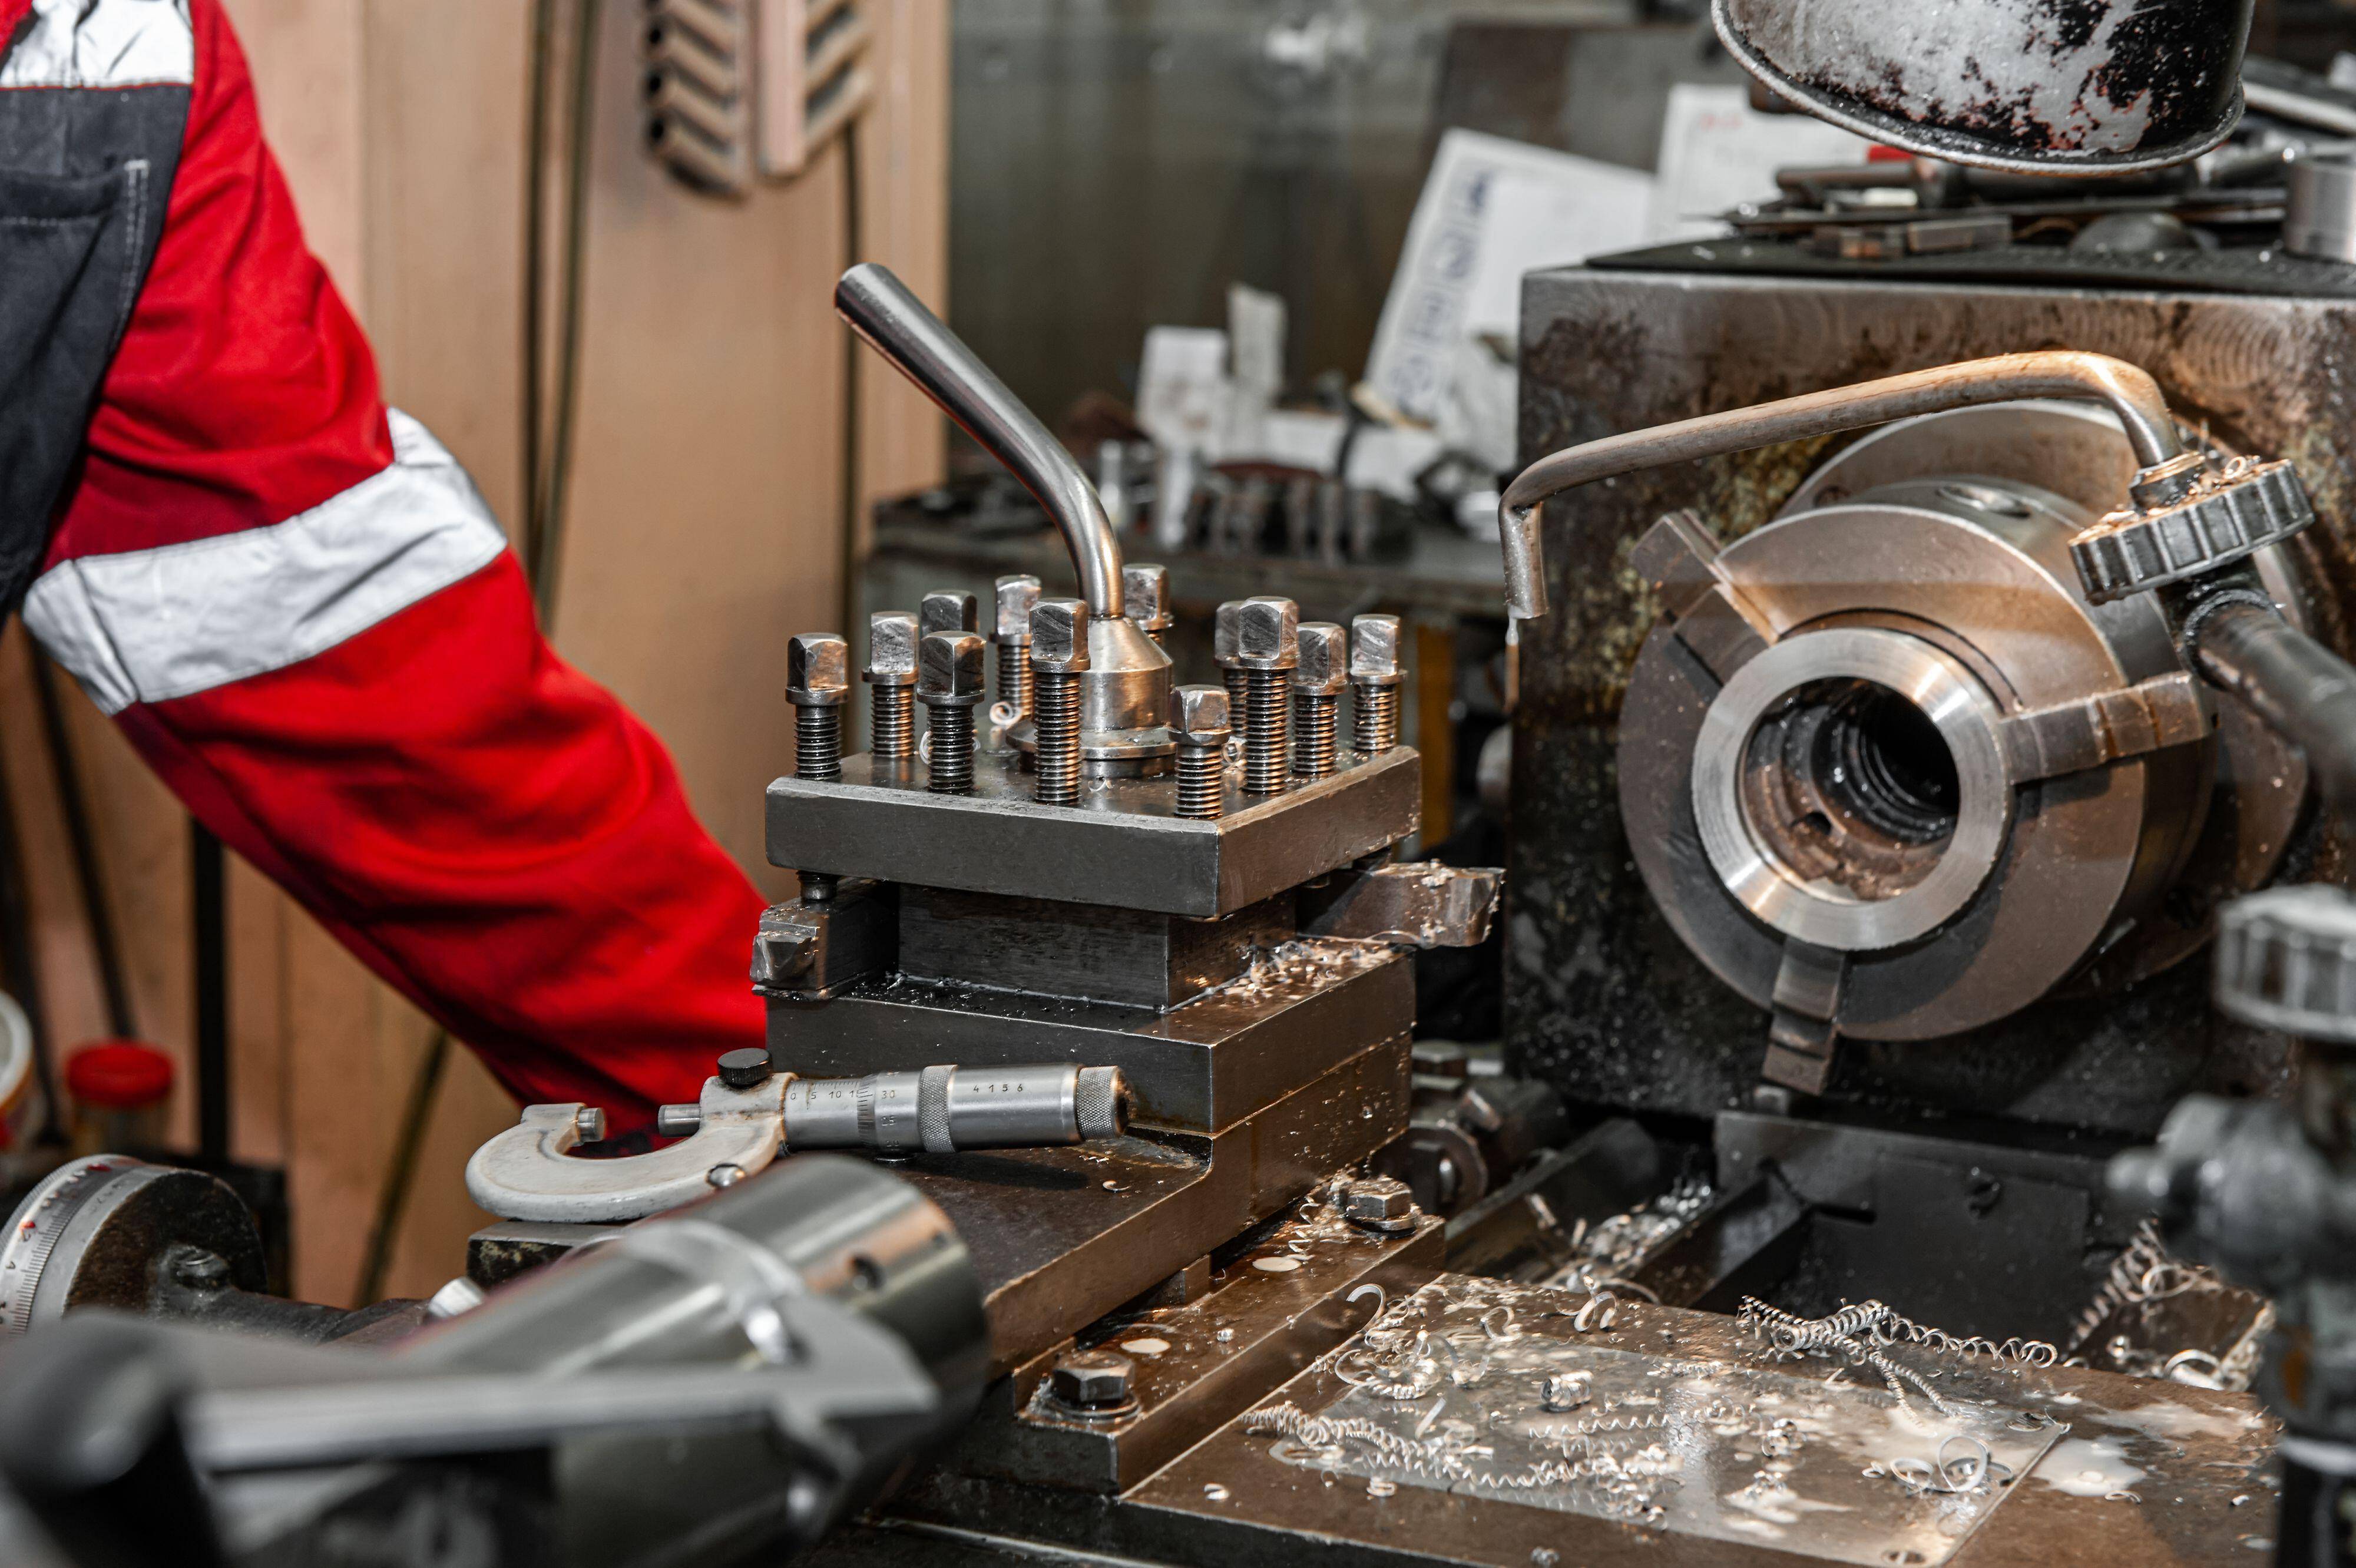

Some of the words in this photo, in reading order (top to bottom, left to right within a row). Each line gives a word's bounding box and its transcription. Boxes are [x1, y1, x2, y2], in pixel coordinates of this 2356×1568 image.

[810, 1091, 817, 1100] 5
[829, 1090, 842, 1099] 10
[881, 1090, 896, 1099] 30
